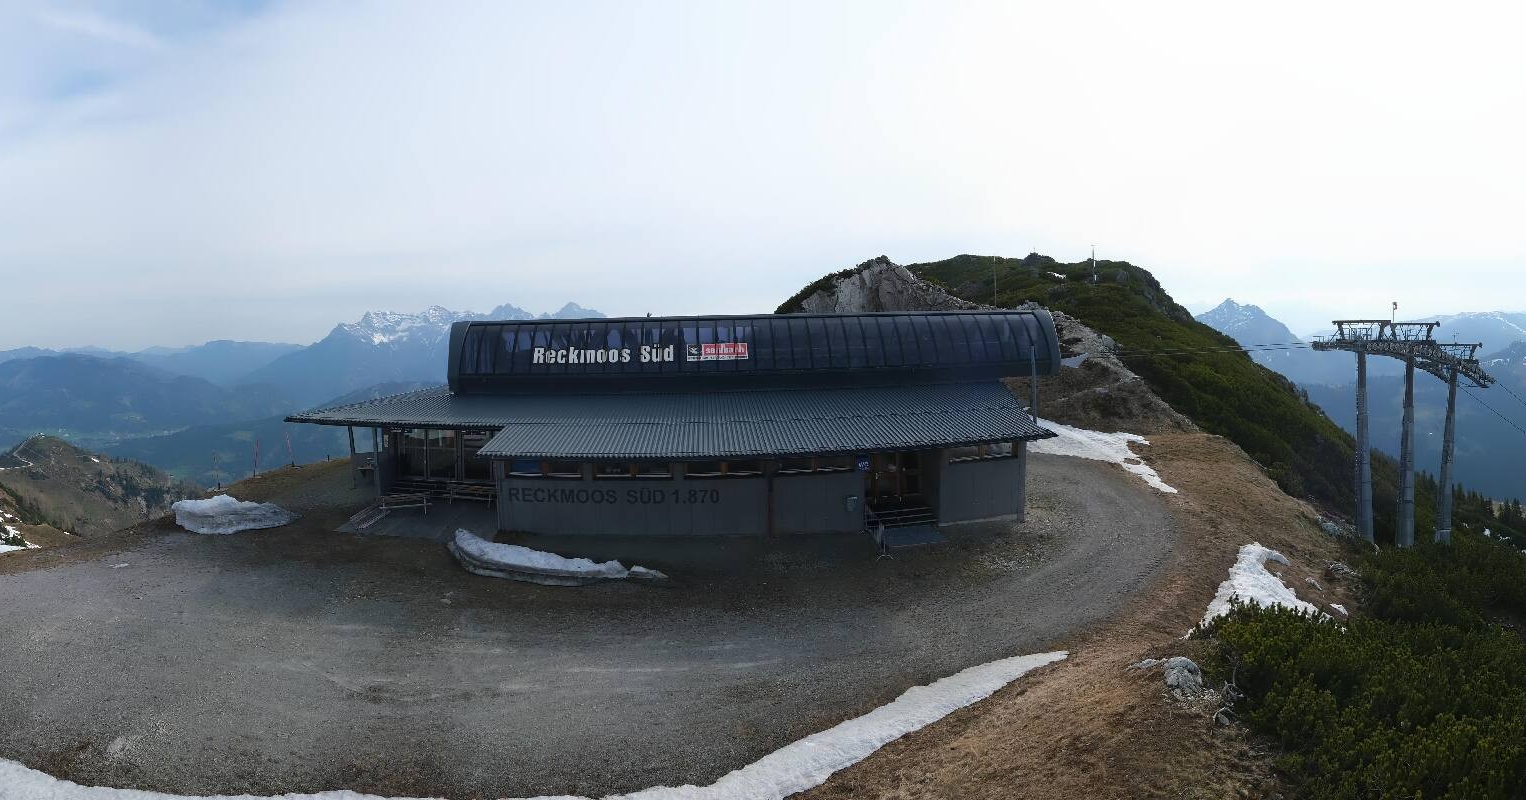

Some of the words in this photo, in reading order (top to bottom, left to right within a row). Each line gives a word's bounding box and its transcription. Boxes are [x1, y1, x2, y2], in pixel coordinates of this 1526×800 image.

[532, 346, 631, 364] Reckmoos
[639, 344, 674, 362] Süd
[508, 487, 618, 504] RECKMOOS
[626, 487, 665, 505] SÜD
[671, 488, 721, 505] 1.870
